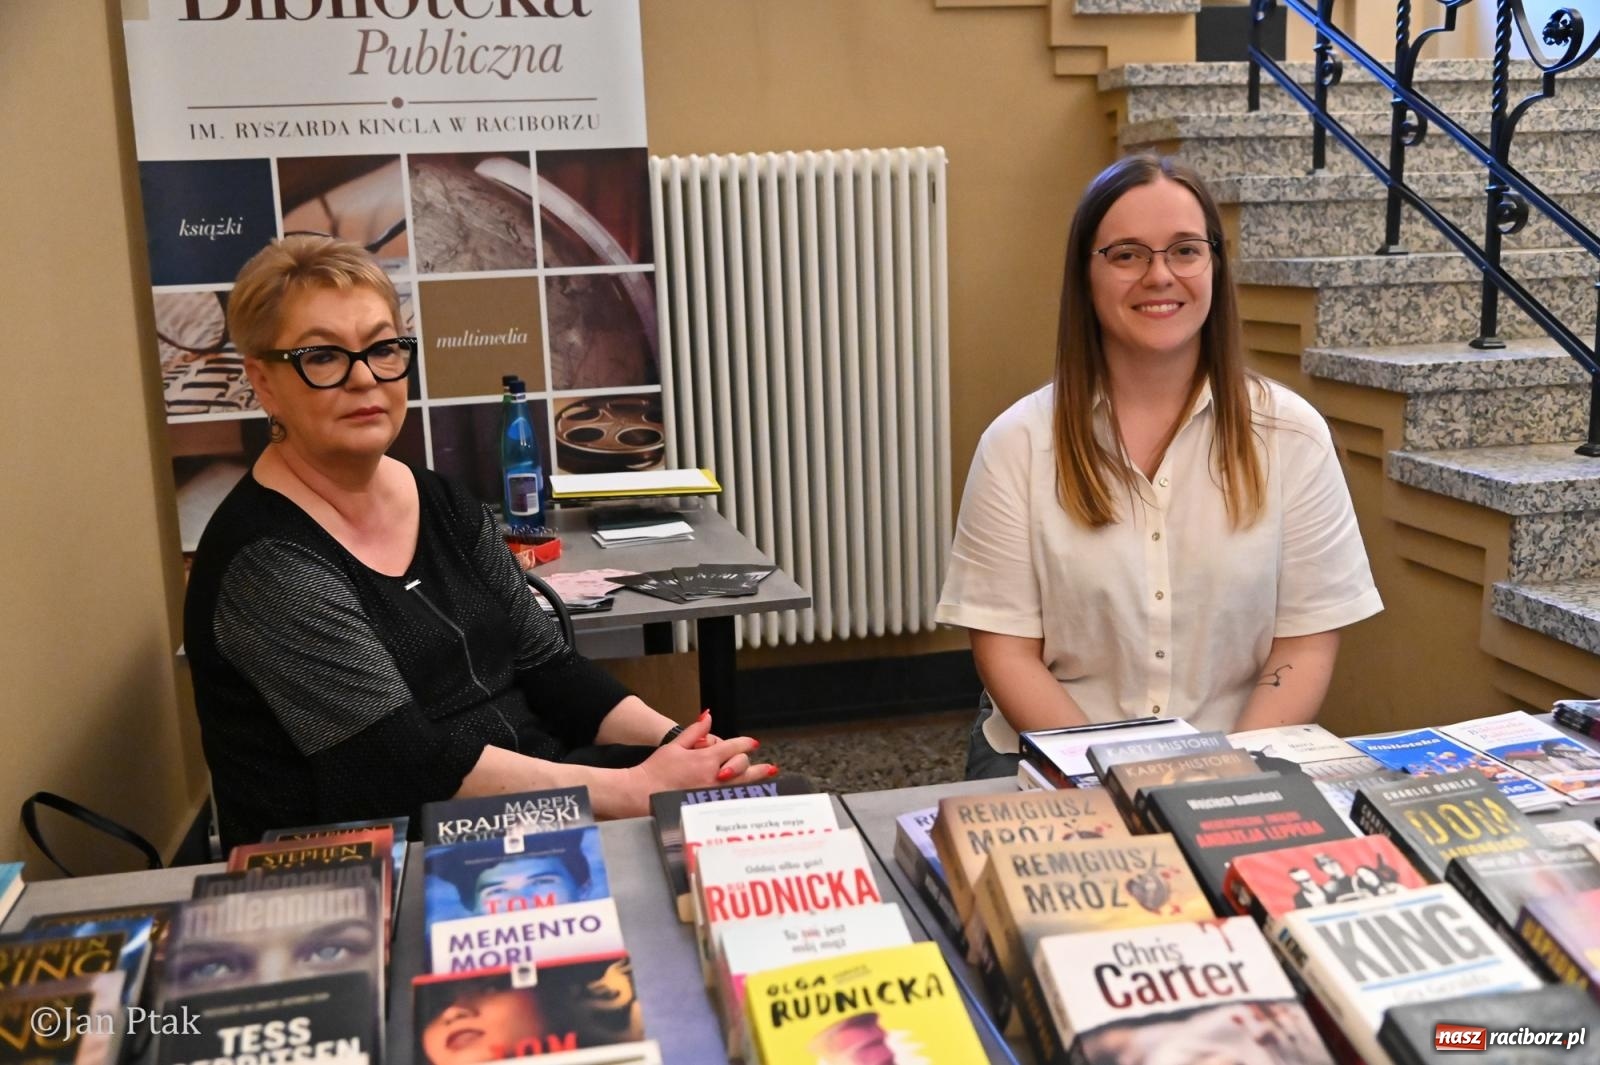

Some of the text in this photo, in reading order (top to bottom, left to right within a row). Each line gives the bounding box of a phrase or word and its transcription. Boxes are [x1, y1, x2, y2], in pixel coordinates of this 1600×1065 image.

[349, 28, 564, 80] Publiczna
[188, 113, 602, 140] IM. RYSZARDA KINCLA W RACIBORZU
[179, 216, 243, 239] książki
[436, 329, 529, 349] multimedia
[1157, 736, 1219, 752] HISTORII
[1125, 754, 1241, 778] KARTY HISTORII
[504, 795, 578, 814] MAREK
[958, 798, 1097, 825] REMIGIUSZ
[437, 805, 581, 838] KRAJEWSKI
[1011, 848, 1168, 878] REMIGIUSZ
[703, 868, 881, 923] RUDNICKA
[448, 915, 602, 953] MEMENTO
[1315, 902, 1497, 983] KING
[451, 945, 533, 973] MORI
[1112, 938, 1185, 967] Chris
[766, 975, 827, 997] OLGA
[1094, 959, 1250, 1009] Carter
[770, 972, 945, 1029] RUDNICKA
[216, 1015, 313, 1057] TESS
